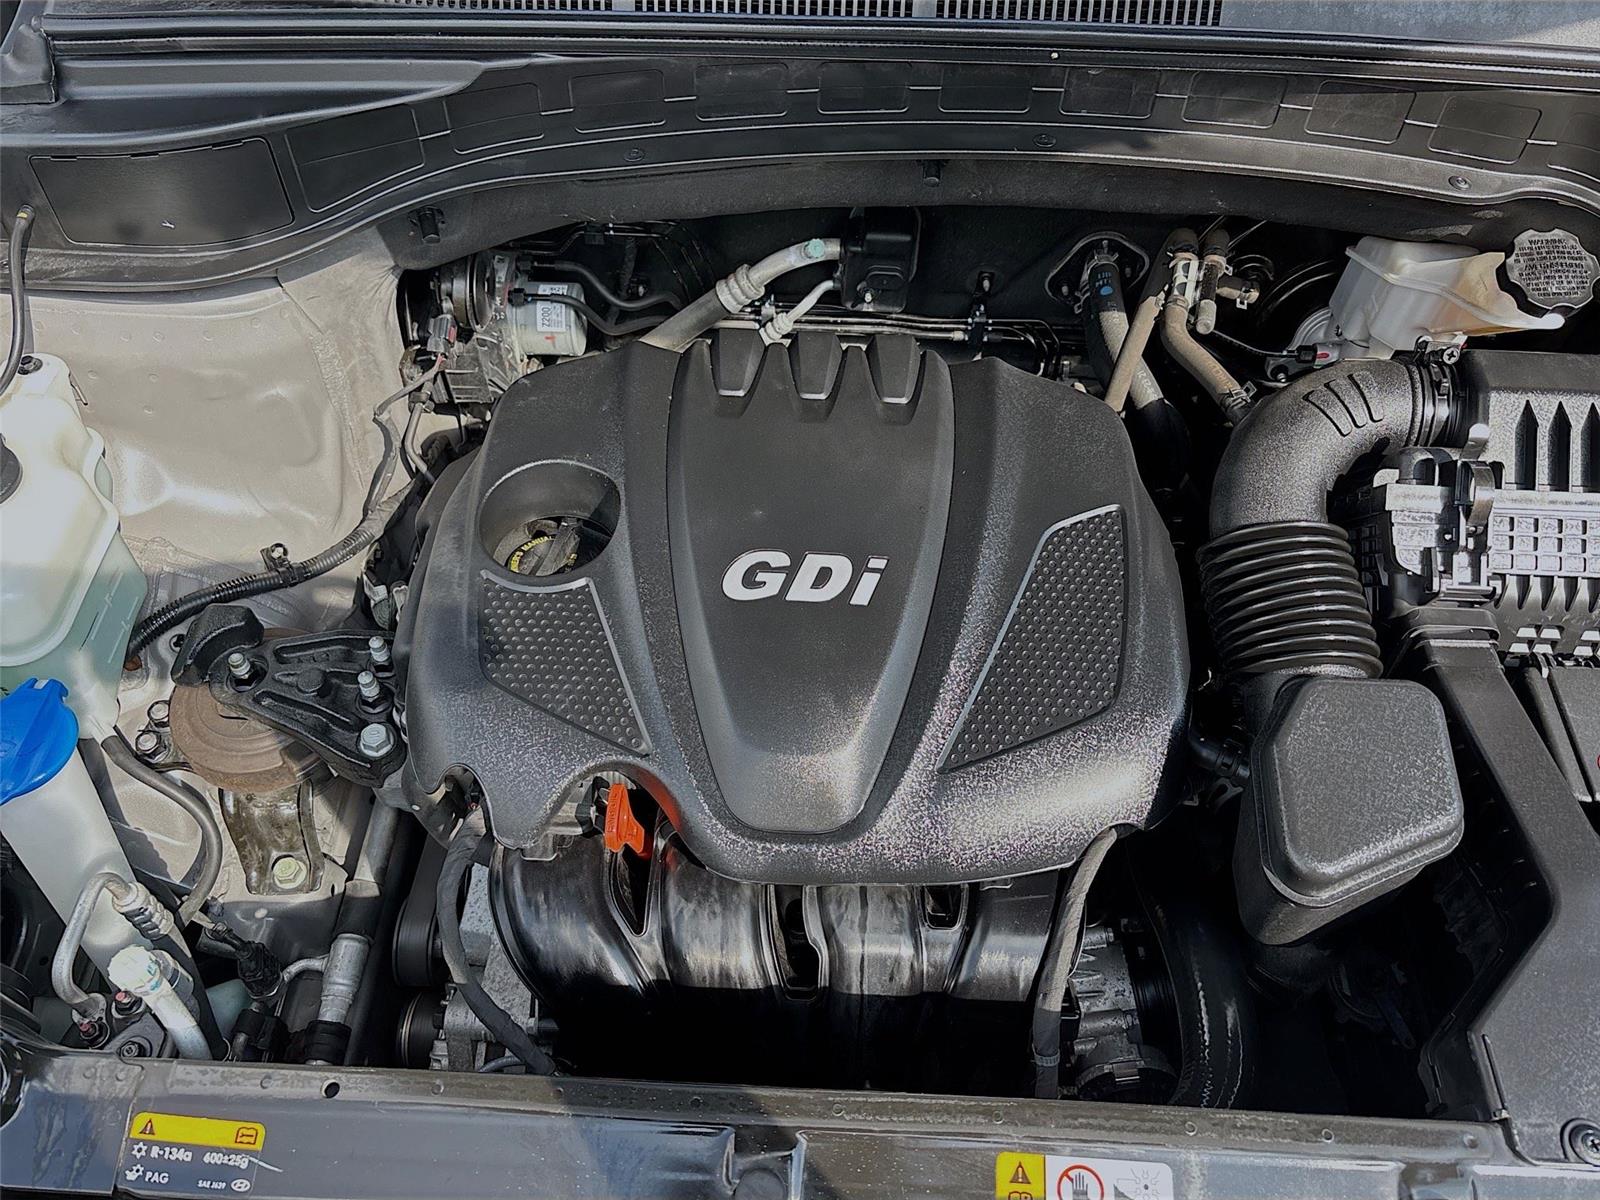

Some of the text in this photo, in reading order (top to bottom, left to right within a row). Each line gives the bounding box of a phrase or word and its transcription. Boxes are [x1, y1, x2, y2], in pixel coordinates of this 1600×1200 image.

[720, 547, 889, 607] GDi
[150, 1145, 249, 1169] R-134a 600±25g
[144, 1171, 169, 1184] PAG
